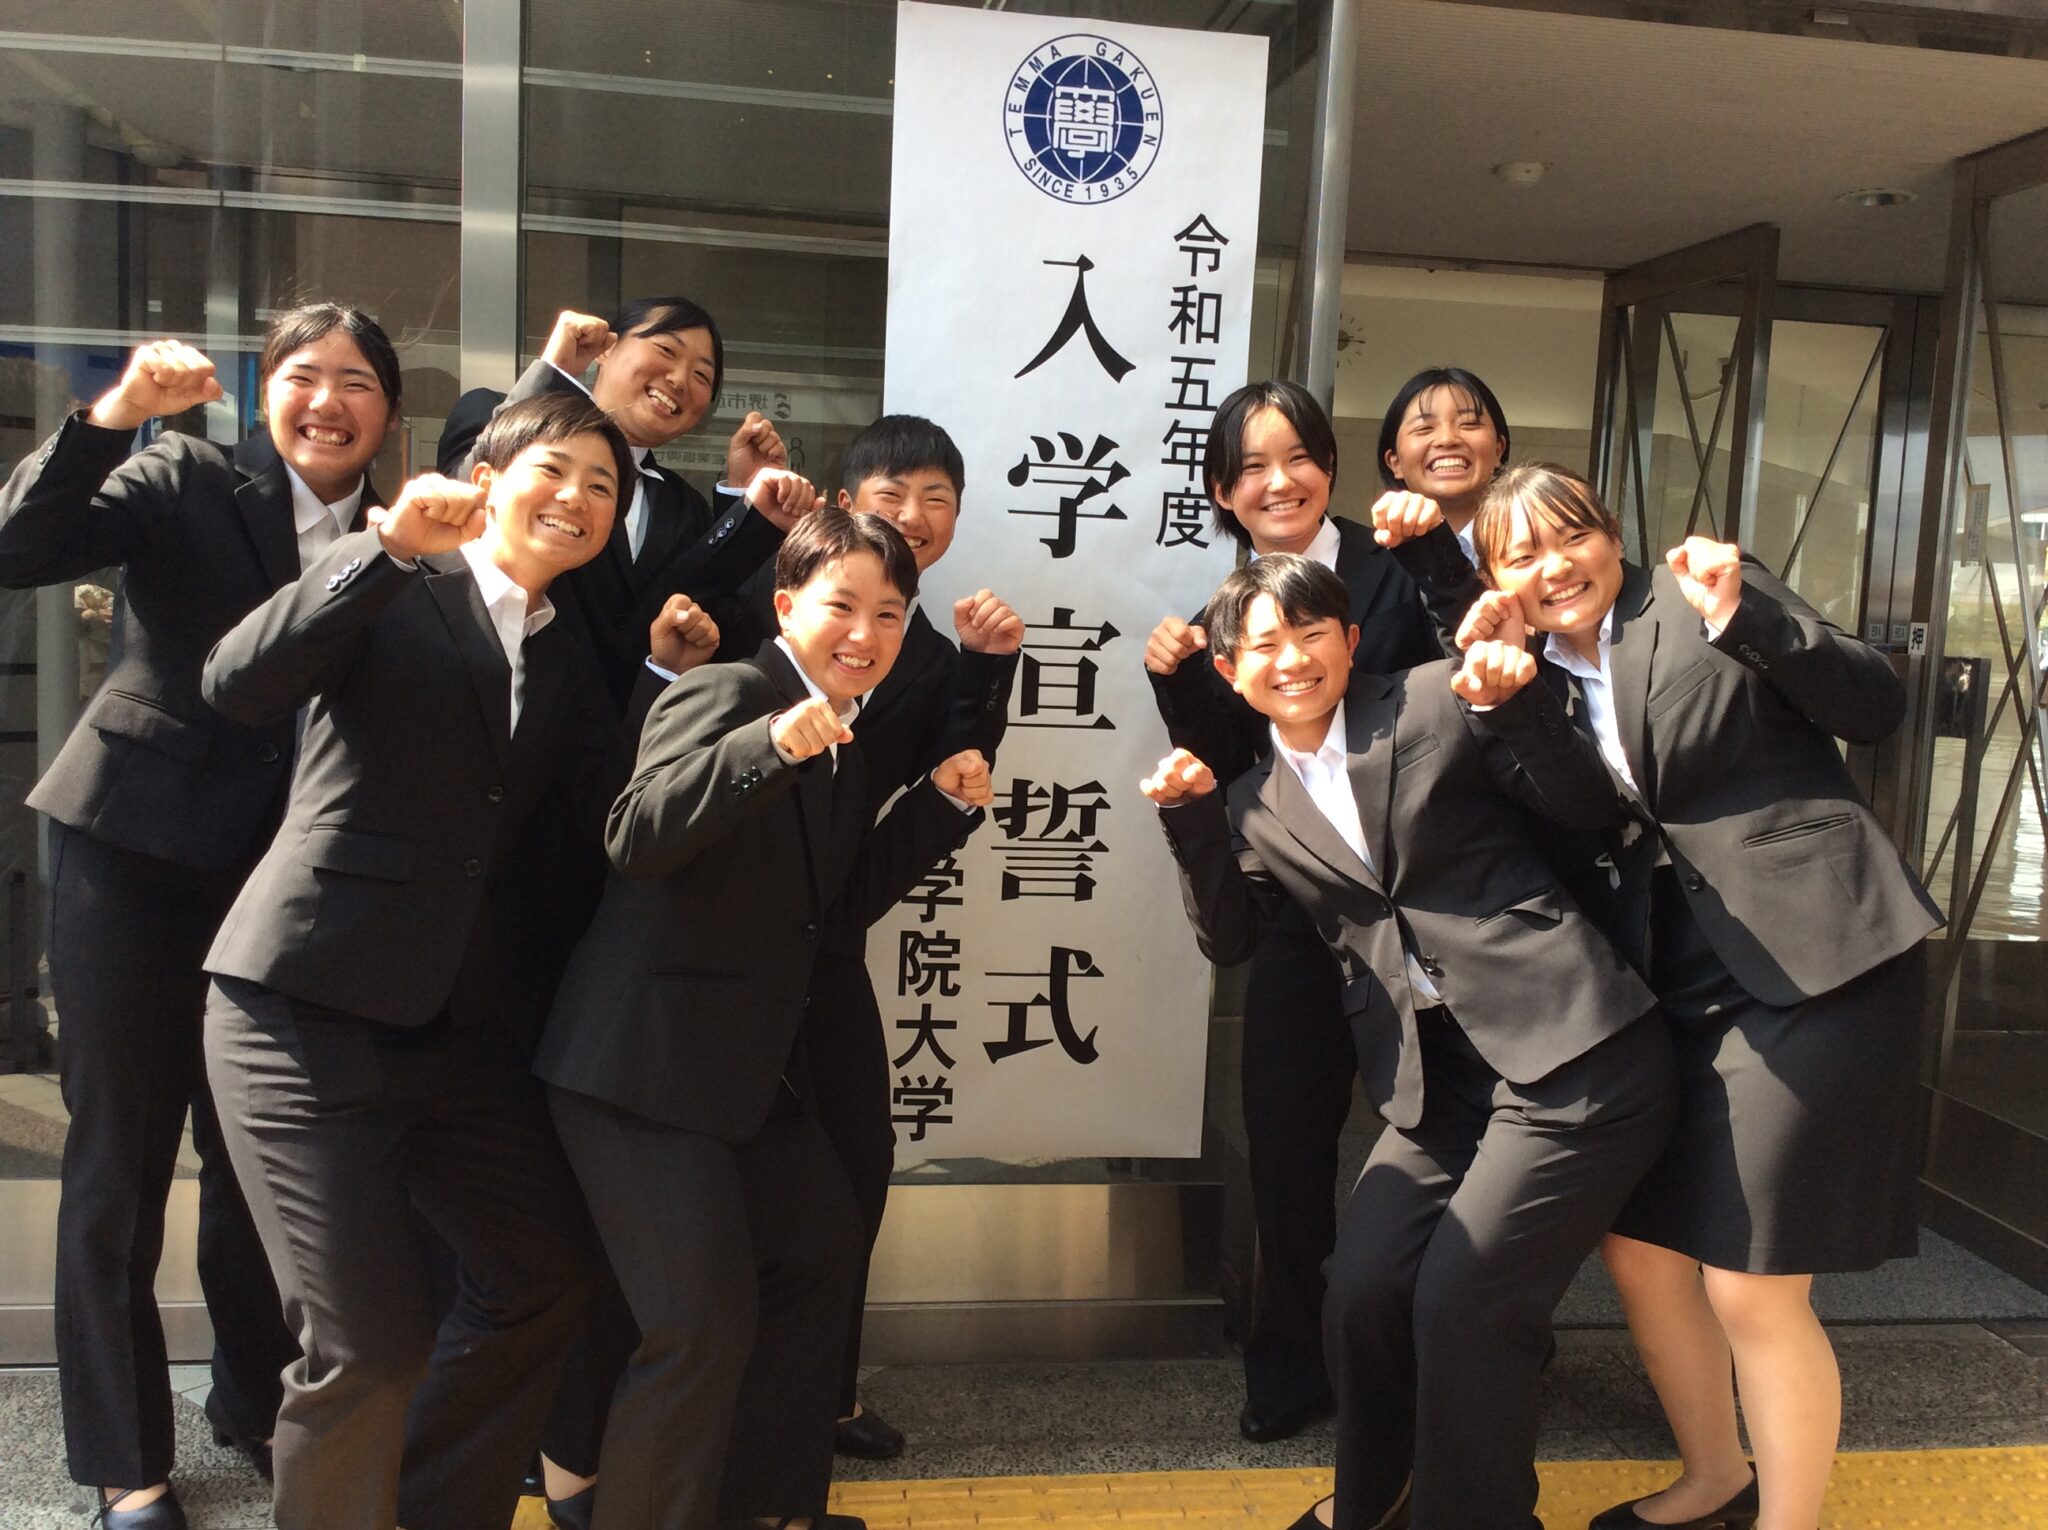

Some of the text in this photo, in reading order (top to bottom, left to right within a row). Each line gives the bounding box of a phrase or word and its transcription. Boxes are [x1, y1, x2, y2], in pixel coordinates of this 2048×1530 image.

[1008, 41, 1159, 147] TEMMA GAKUEN
[1024, 157, 1138, 200] SINCE 1935
[1156, 214, 1230, 550] 令和五年度
[983, 253, 1137, 1065] 入学宣誓式
[1911, 627, 1924, 650] 押
